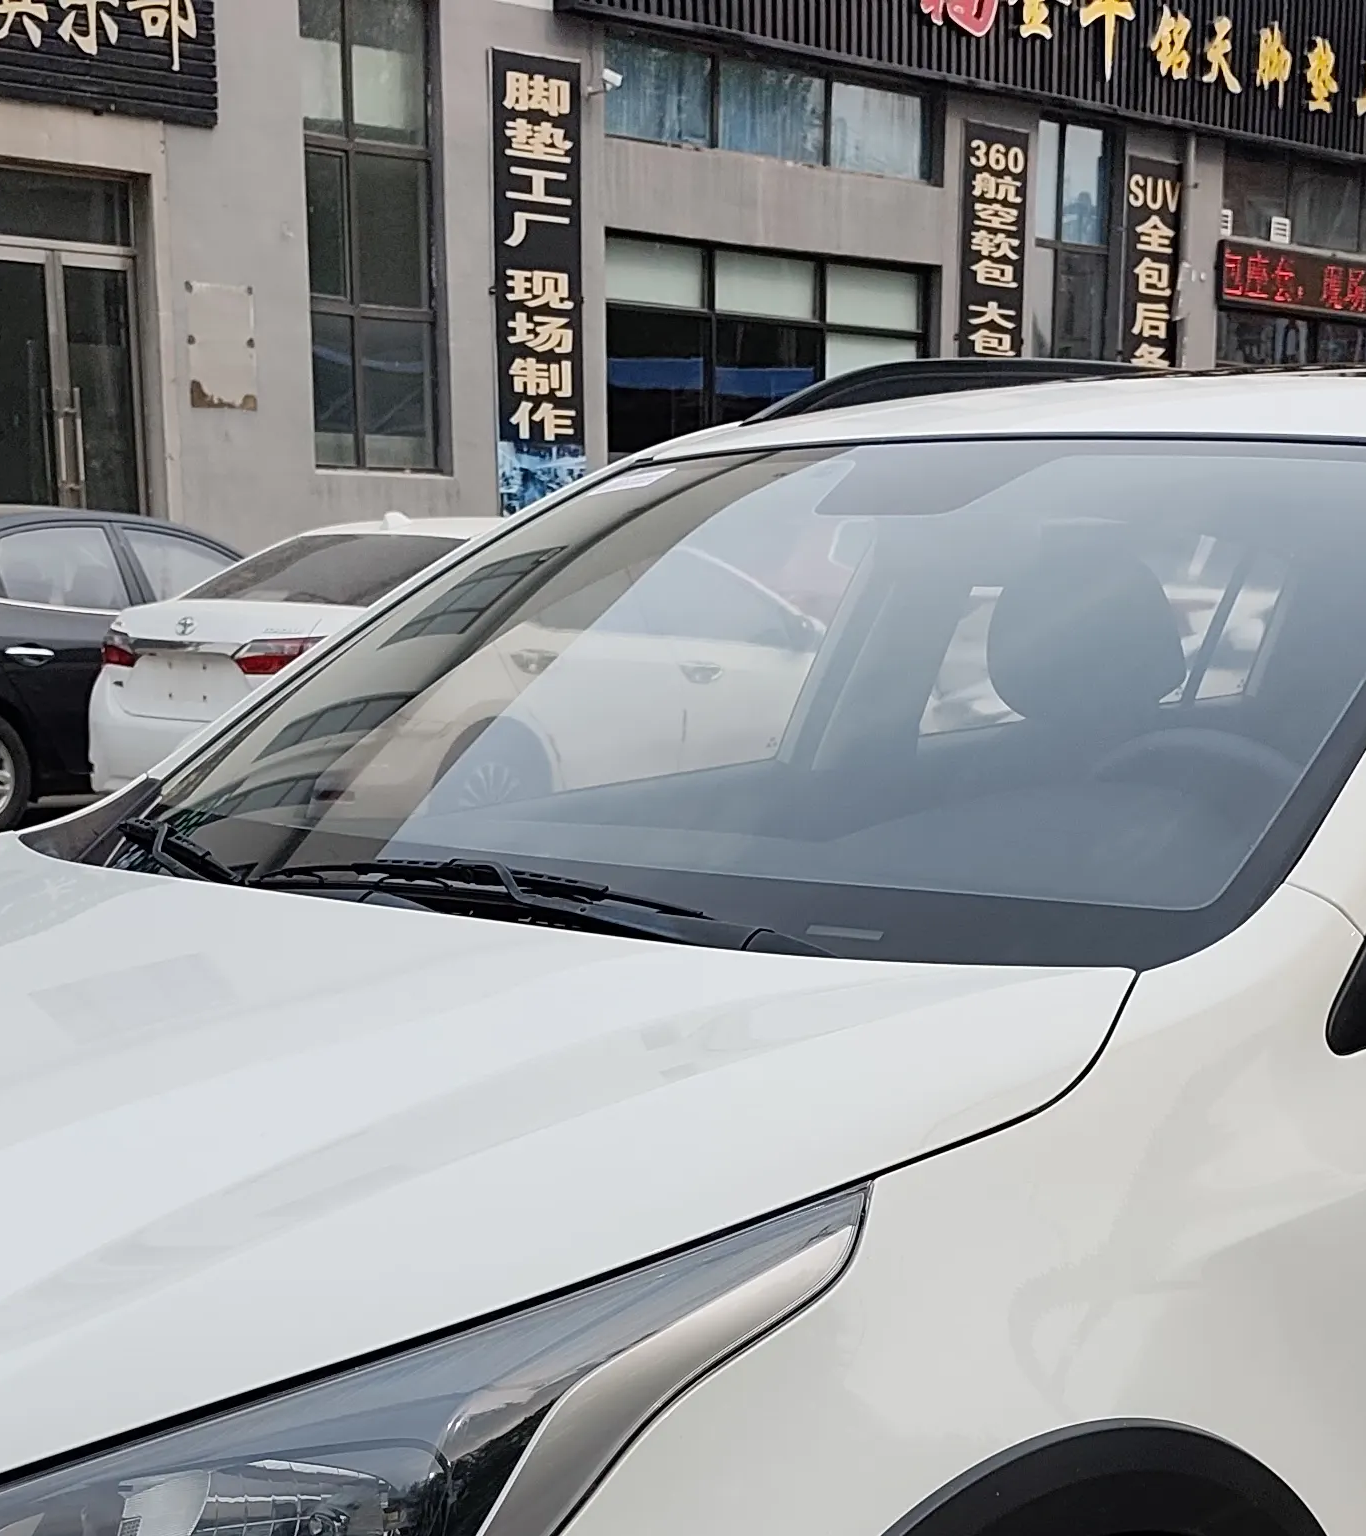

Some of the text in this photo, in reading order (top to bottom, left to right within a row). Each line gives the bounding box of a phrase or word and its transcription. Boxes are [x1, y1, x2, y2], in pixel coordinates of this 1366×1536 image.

[503, 70, 576, 442] 脚垫工厂 现场制作
